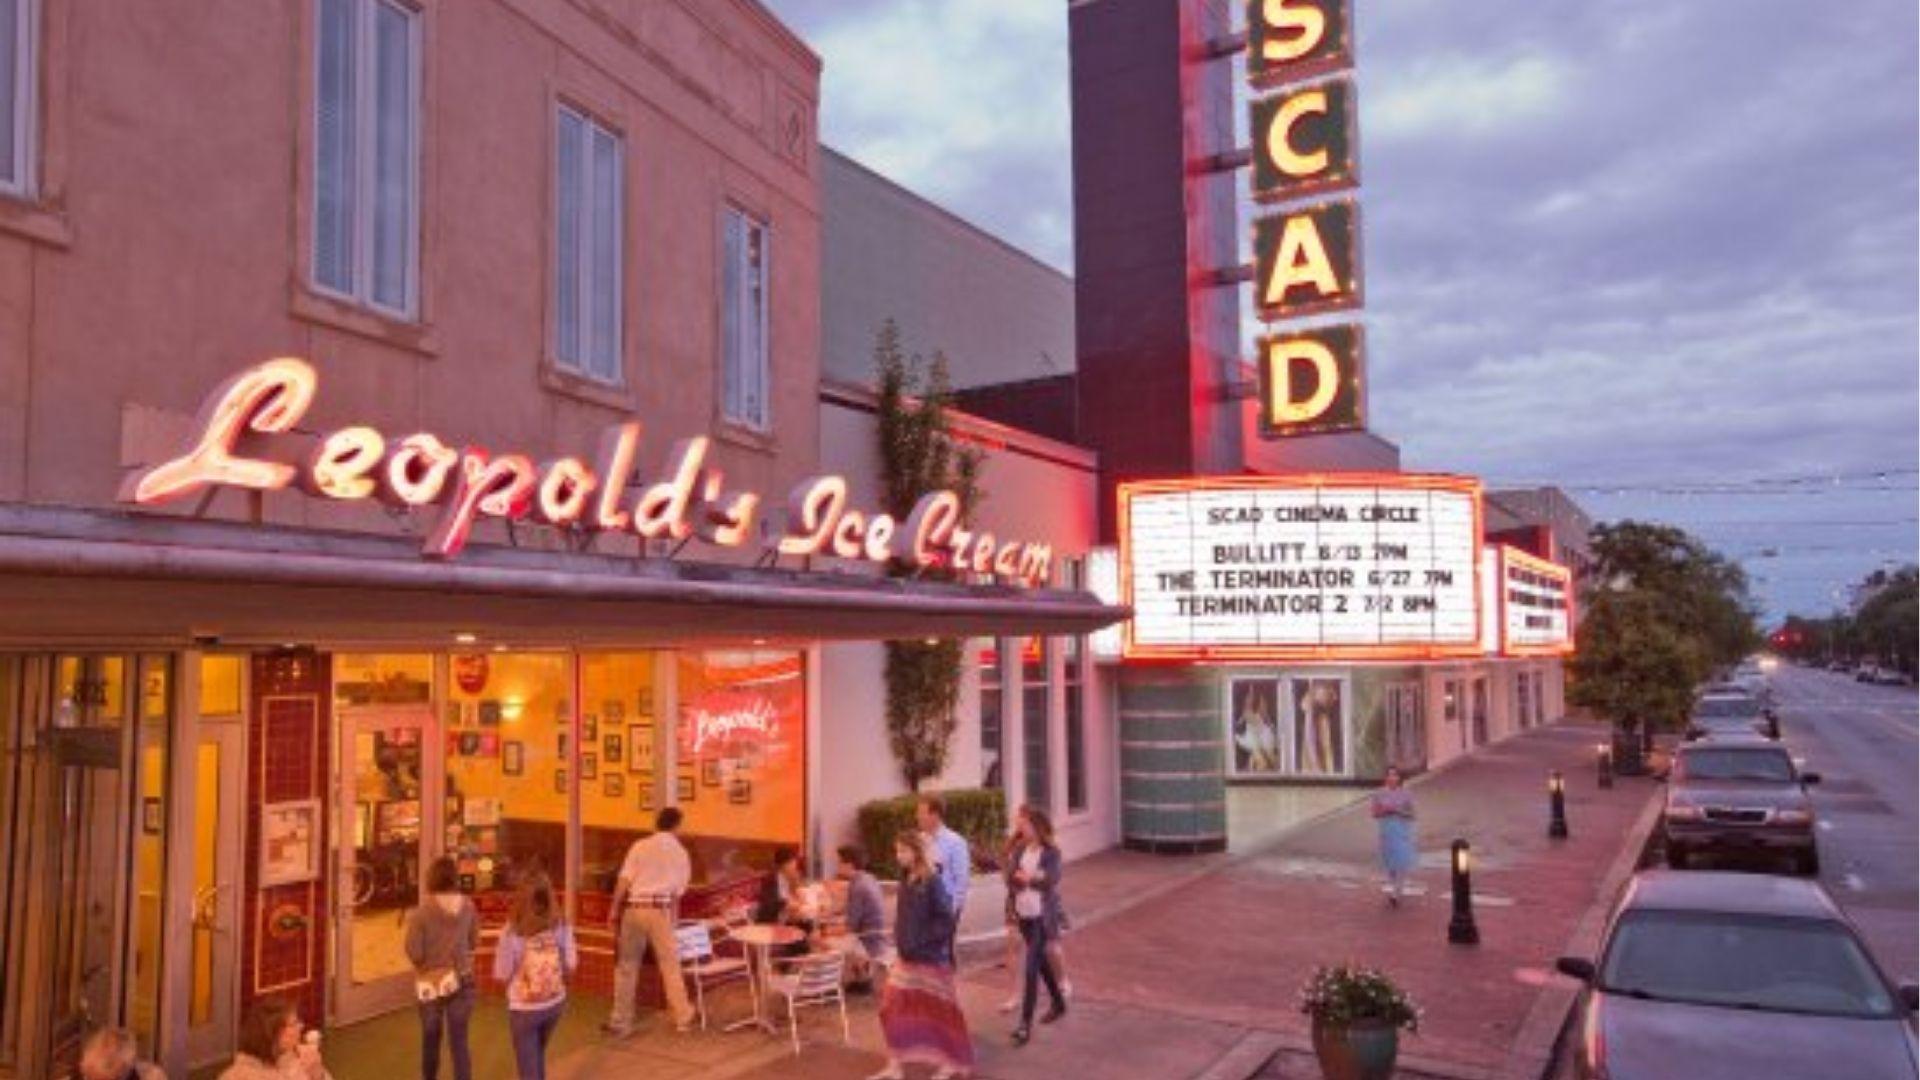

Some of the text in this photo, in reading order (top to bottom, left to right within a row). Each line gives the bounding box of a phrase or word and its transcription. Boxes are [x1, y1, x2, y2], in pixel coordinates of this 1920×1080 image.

[1262, 0, 1341, 425] SCAD
[134, 357, 1053, 580] Leopold's Ice Cream
[1207, 505, 1420, 525] SCAD CINEMA CIRCLE
[1213, 542, 1306, 565] BULLITT
[1373, 542, 1408, 561] 7PM
[1157, 567, 1454, 592] THE TERMINATOR 6/27 7PM
[1175, 594, 1322, 617] TERMINATOR
[1334, 594, 1349, 613] 2
[1402, 594, 1437, 613] 8PM
